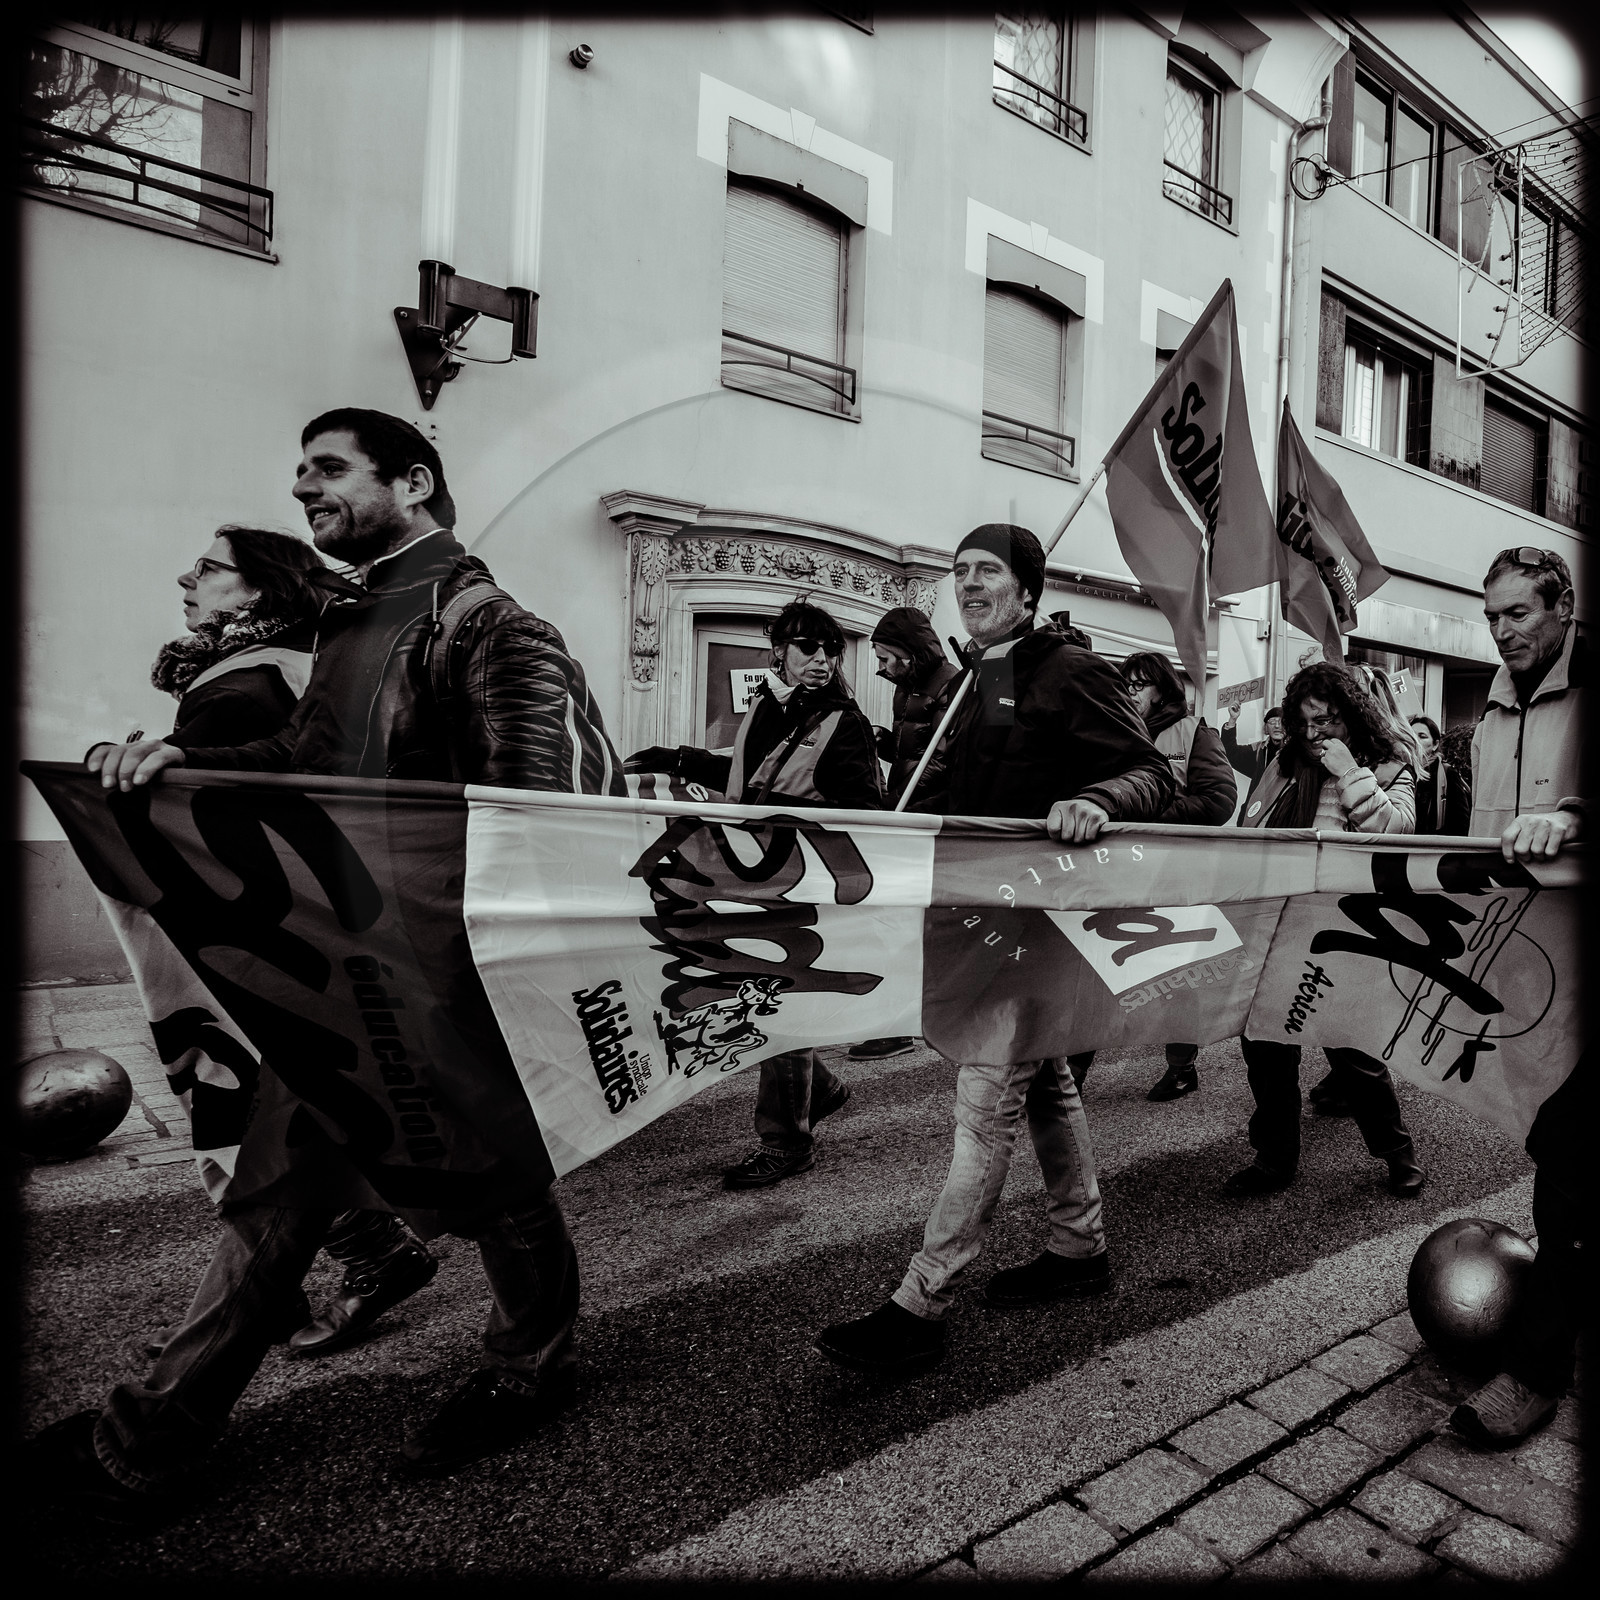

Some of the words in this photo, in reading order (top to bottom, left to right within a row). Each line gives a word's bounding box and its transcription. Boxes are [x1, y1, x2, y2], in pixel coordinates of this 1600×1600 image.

[1076, 584, 1129, 601] ÉGALITÉ
[744, 674, 753, 683] En
[998, 844, 1144, 908] santé
[1118, 950, 1255, 1014] Solidaires
[1284, 960, 1334, 1034] Aérien
[344, 954, 447, 1164] éducation
[571, 980, 640, 1114] Solidaires
[629, 1059, 650, 1097] syndicale
[640, 1053, 652, 1080] Union
